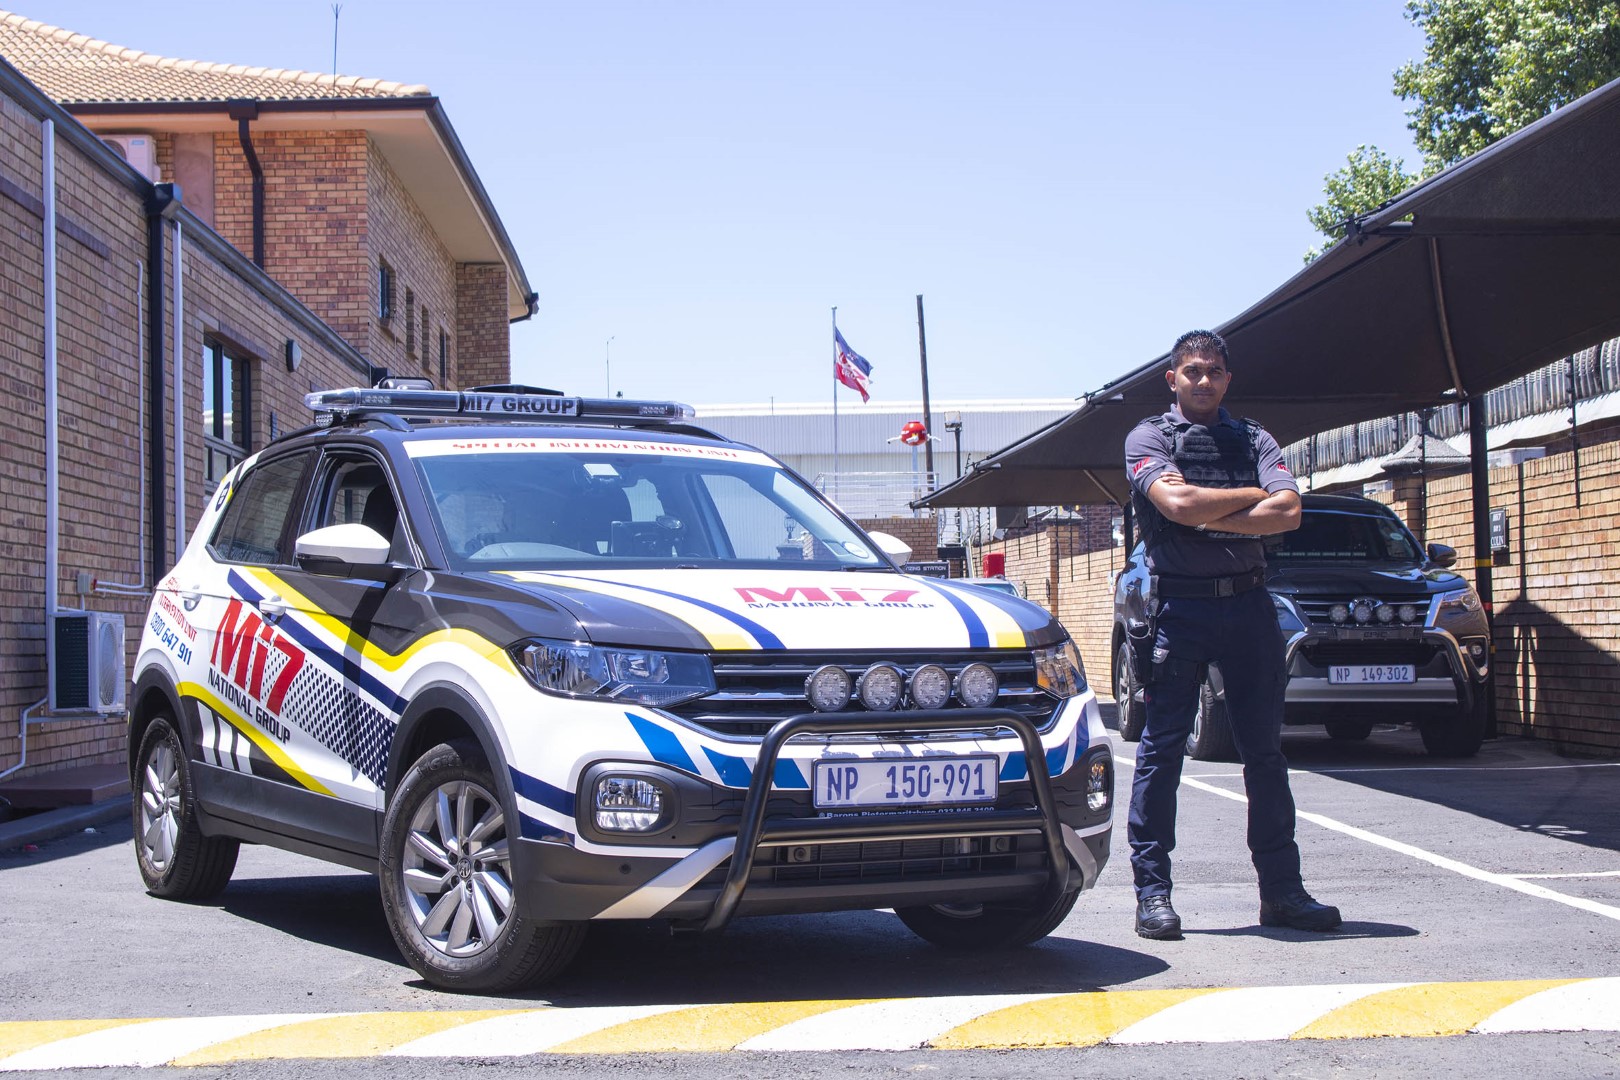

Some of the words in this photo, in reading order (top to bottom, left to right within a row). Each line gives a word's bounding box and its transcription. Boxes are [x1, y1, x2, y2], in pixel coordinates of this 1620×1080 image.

[501, 398, 574, 414] GROUP
[733, 587, 919, 603] Mi7
[747, 601, 860, 609] NATIONAL
[863, 601, 935, 609] GROUP
[161, 627, 179, 651] 647
[177, 642, 193, 666] 911
[210, 595, 306, 717] Mi7
[1336, 667, 1351, 681] NP
[207, 666, 253, 718] NATIONAL
[255, 704, 291, 745] GROUP
[827, 766, 859, 801] NP
[885, 762, 985, 799] 150-991
